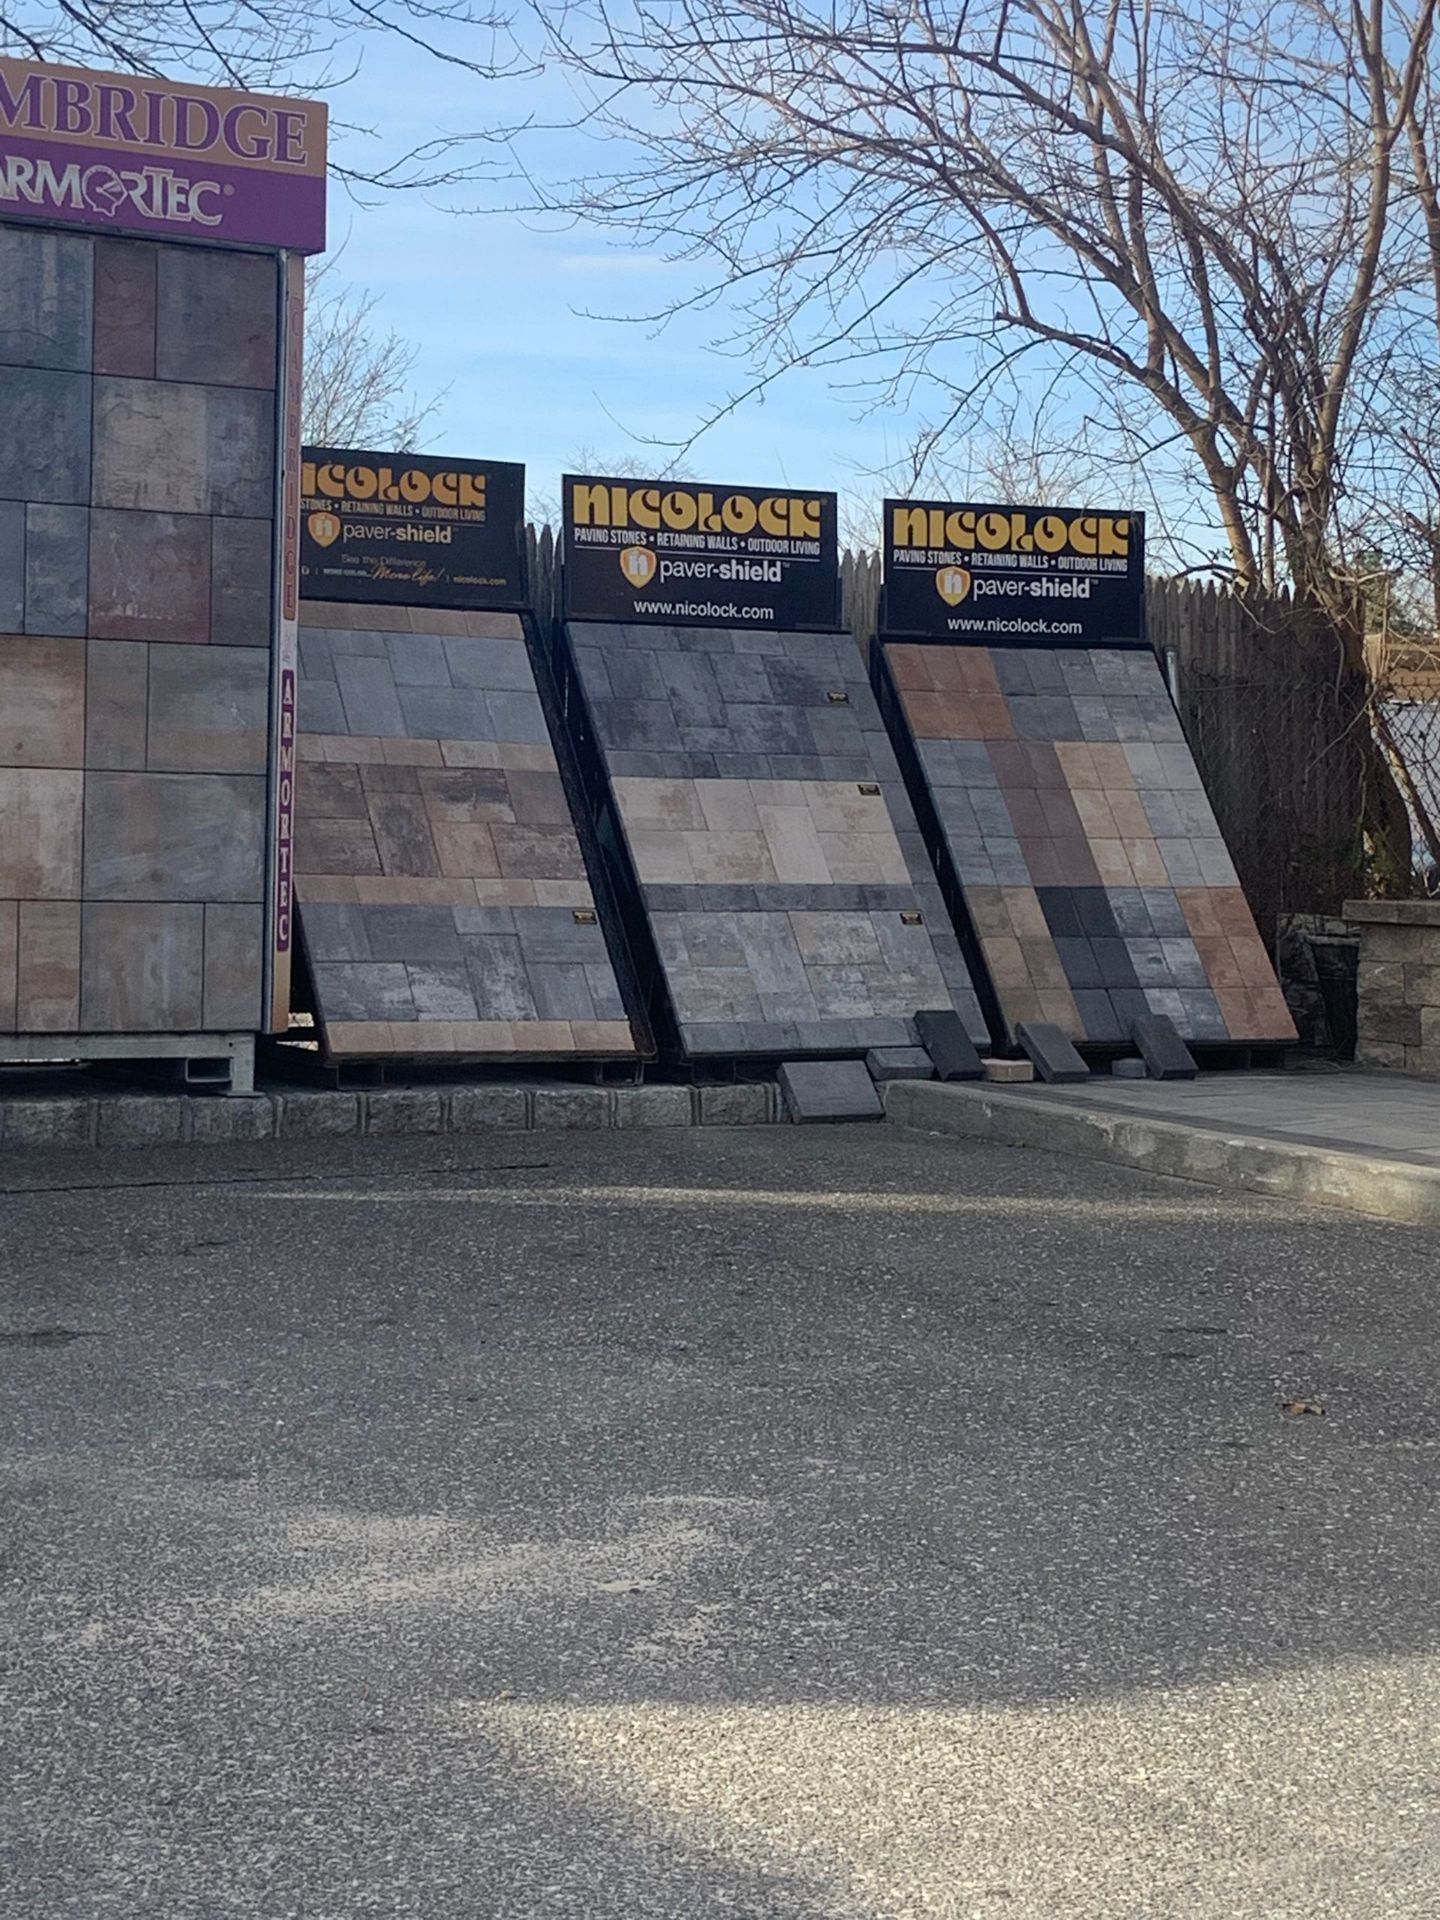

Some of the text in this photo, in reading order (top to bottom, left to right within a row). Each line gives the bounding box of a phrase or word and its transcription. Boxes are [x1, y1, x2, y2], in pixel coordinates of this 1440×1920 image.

[386, 503, 413, 517] WALLS
[421, 506, 459, 520] OUTDOOR
[460, 508, 486, 522] LIVING
[573, 484, 820, 538] NICOLOCK
[343, 523, 452, 544] paver-shield
[574, 527, 820, 555] PAVING STONES RETAINING WALLS OUTDOOR LIVING
[893, 507, 1129, 555] NICOLOCK
[660, 559, 782, 584] paver-shield
[893, 549, 1128, 572] PAVING STONES RETAINING WALLS OUTDOOR LIVING
[973, 577, 1090, 602] paver-shield
[633, 600, 774, 620] www.nicolock.com
[947, 617, 1083, 634] www.nicolock.com
[279, 678, 293, 942] ARMORTEC
